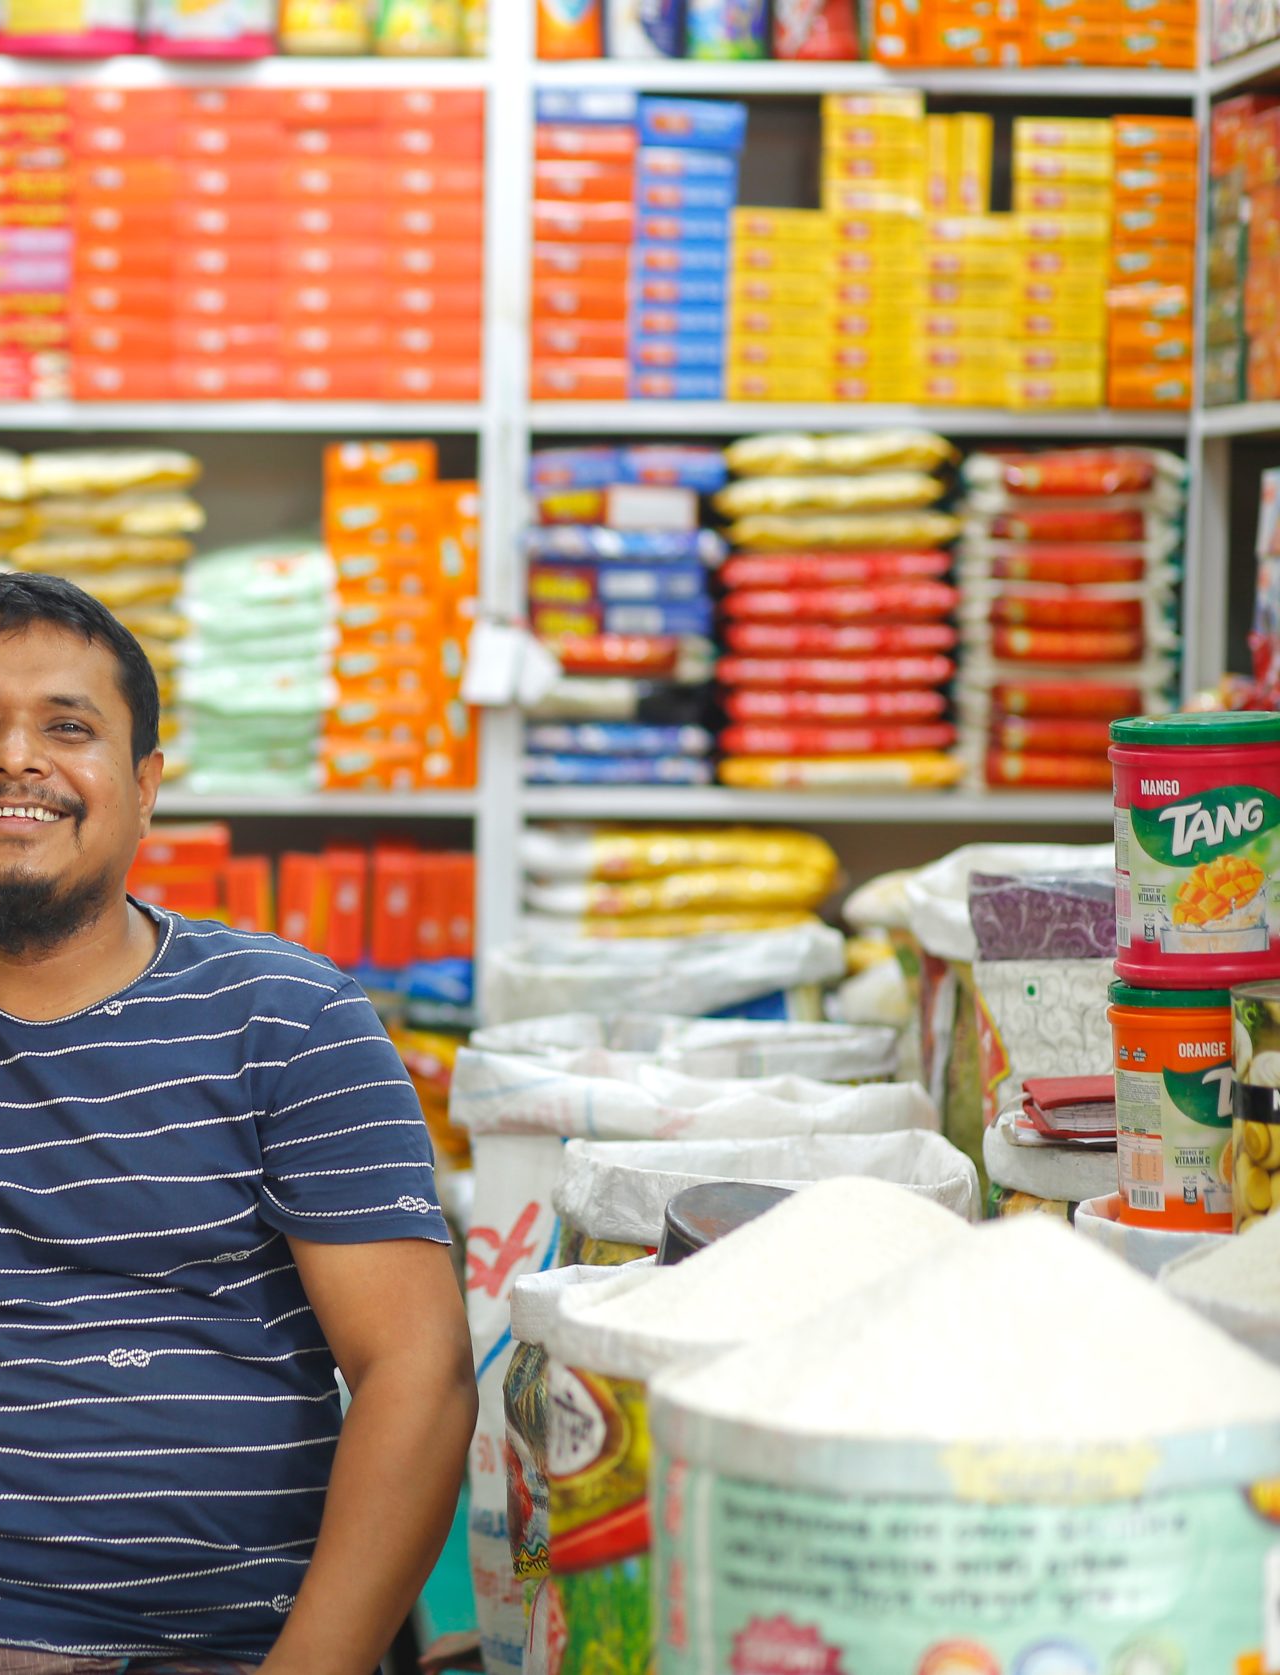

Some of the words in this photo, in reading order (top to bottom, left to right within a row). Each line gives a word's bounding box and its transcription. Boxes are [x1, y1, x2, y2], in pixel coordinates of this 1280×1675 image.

[1140, 779, 1180, 796] MANGO
[1158, 798, 1264, 857] TANG
[1138, 893, 1161, 903] VITAMIN
[1162, 894, 1166, 903] C
[1178, 1042, 1227, 1058] ORANGE
[1175, 1155, 1204, 1165] VITAMIN
[1205, 1155, 1210, 1165] C
